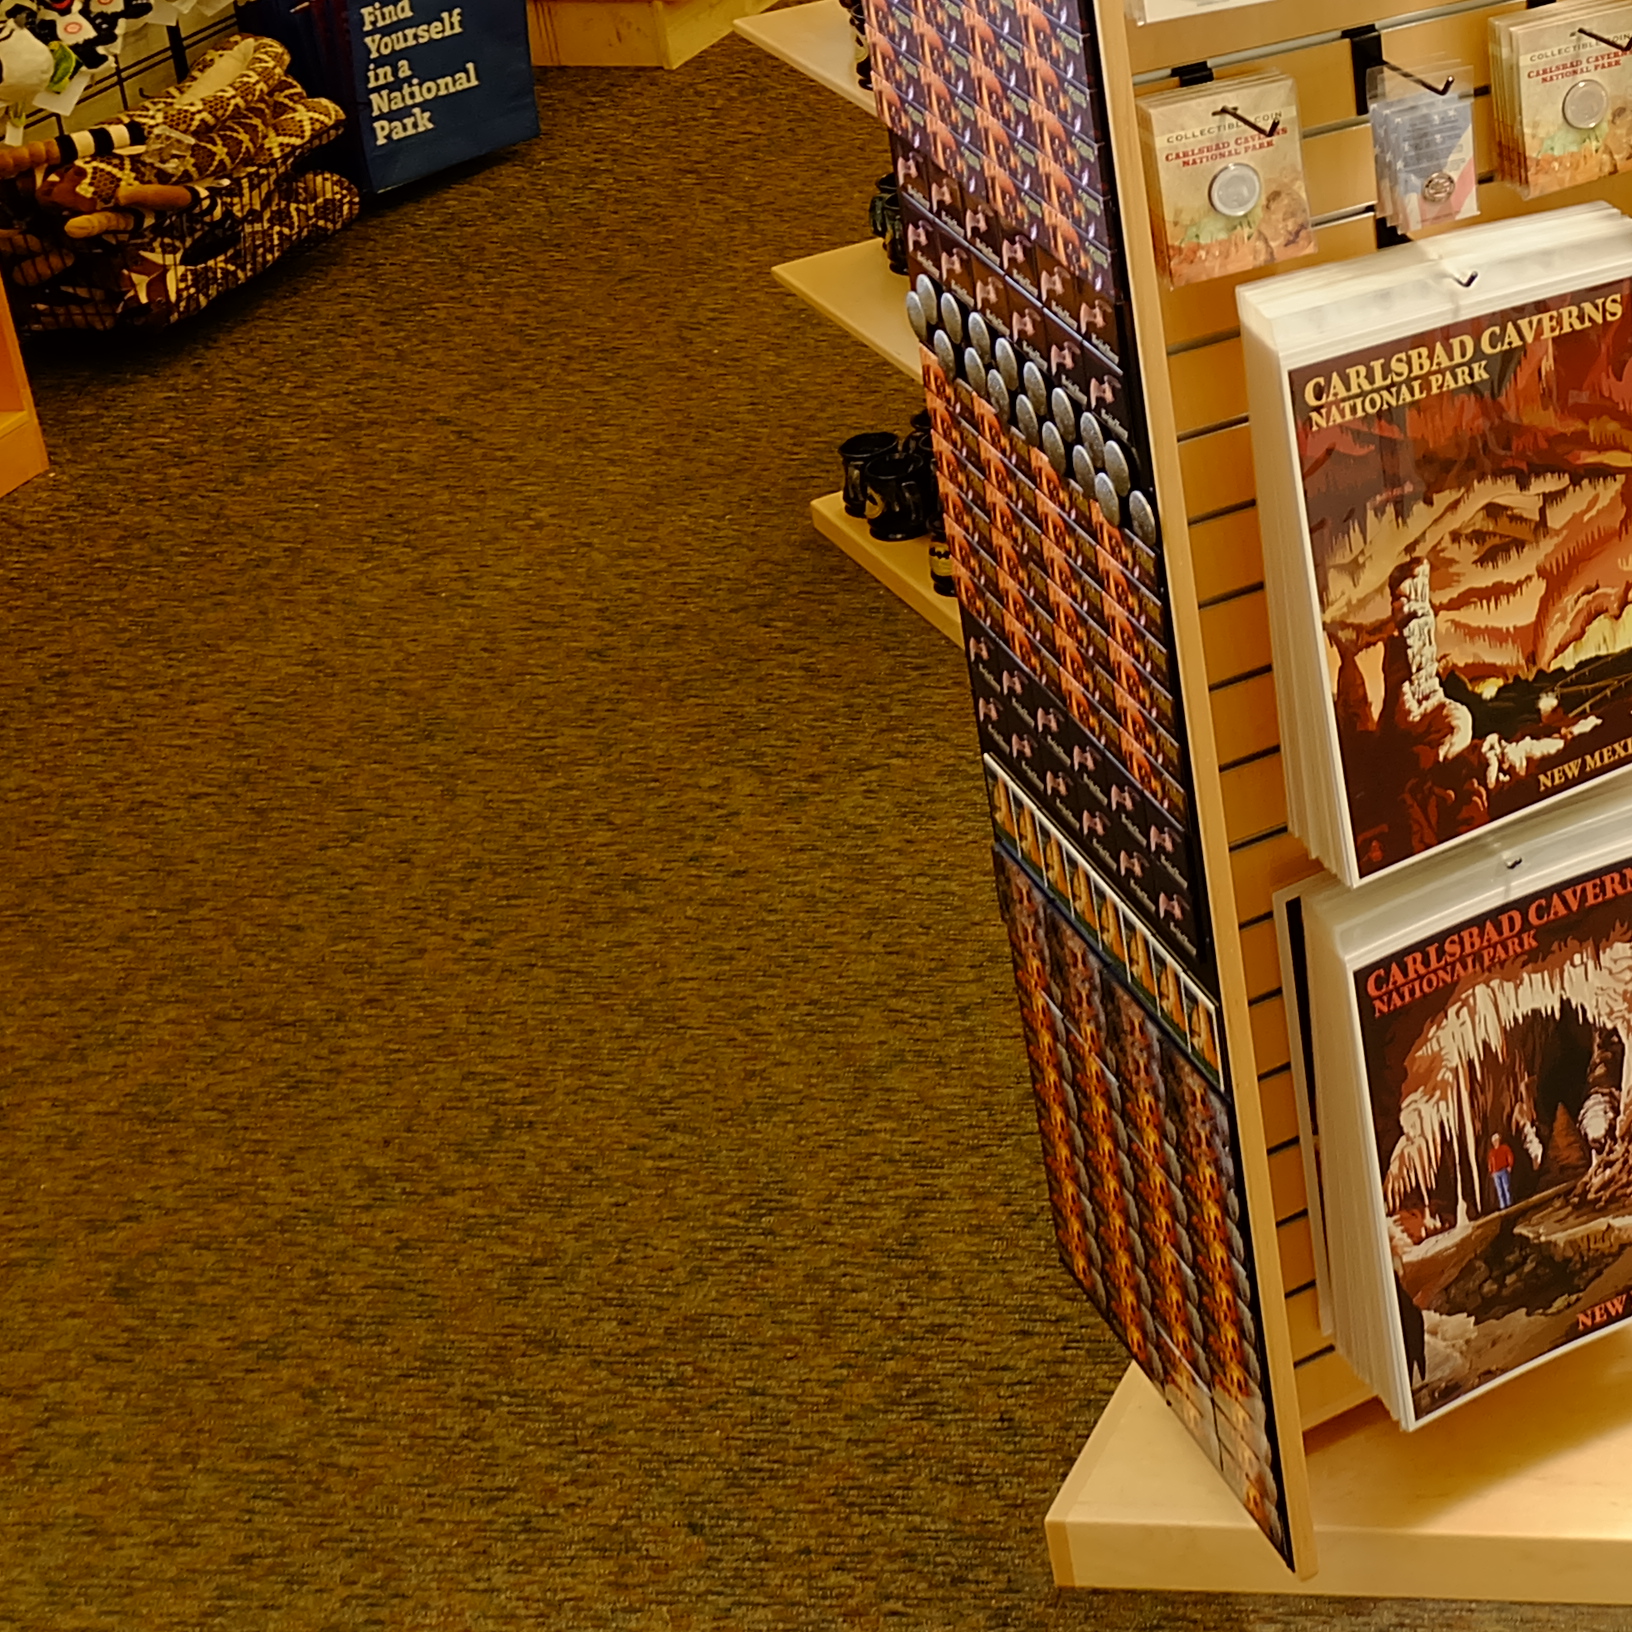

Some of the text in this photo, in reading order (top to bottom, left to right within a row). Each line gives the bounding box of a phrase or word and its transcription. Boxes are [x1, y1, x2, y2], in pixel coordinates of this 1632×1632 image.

[363, 7, 463, 59] Yourself
[367, 59, 413, 89] in a
[1527, 59, 1583, 80] CARLSBAD
[1541, 59, 1622, 84] NATIONAL PARK
[368, 61, 480, 117] National
[372, 107, 435, 146] Park
[1253, 110, 1284, 123] COIN
[1165, 140, 1231, 163] CARLSBAD
[1181, 137, 1275, 167] NATIONAL PARK
[1304, 293, 1624, 407] CARLSBAD CAVERNS
[1309, 360, 1490, 432] NATIONAL PARK
[1538, 758, 1583, 792] NEW
[1366, 908, 1523, 998] CARLSBAD
[1372, 929, 1539, 1018] NATIONAL PARK
[1576, 1293, 1628, 1331] NEW
